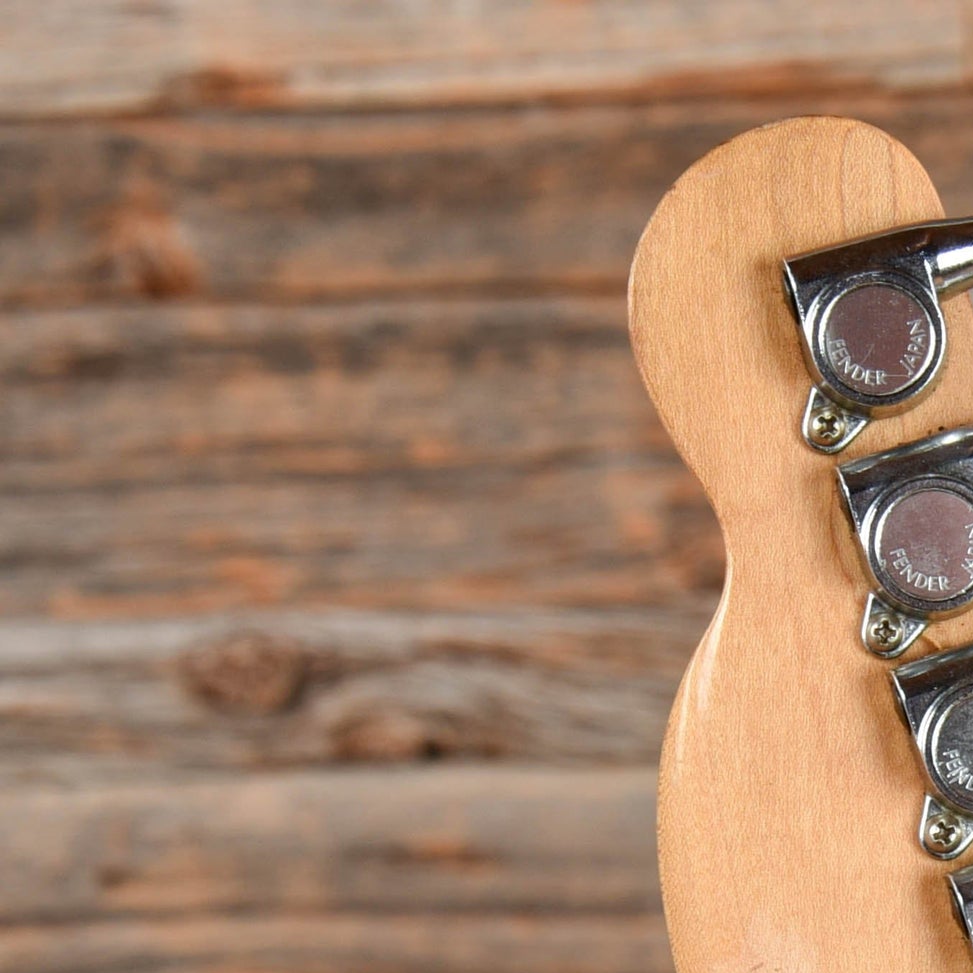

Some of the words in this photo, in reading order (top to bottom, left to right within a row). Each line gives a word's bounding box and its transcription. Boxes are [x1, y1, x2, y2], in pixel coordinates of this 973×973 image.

[829, 339, 887, 386] FENDER
[900, 319, 926, 377] JAPAN
[890, 548, 950, 591] FENDER
